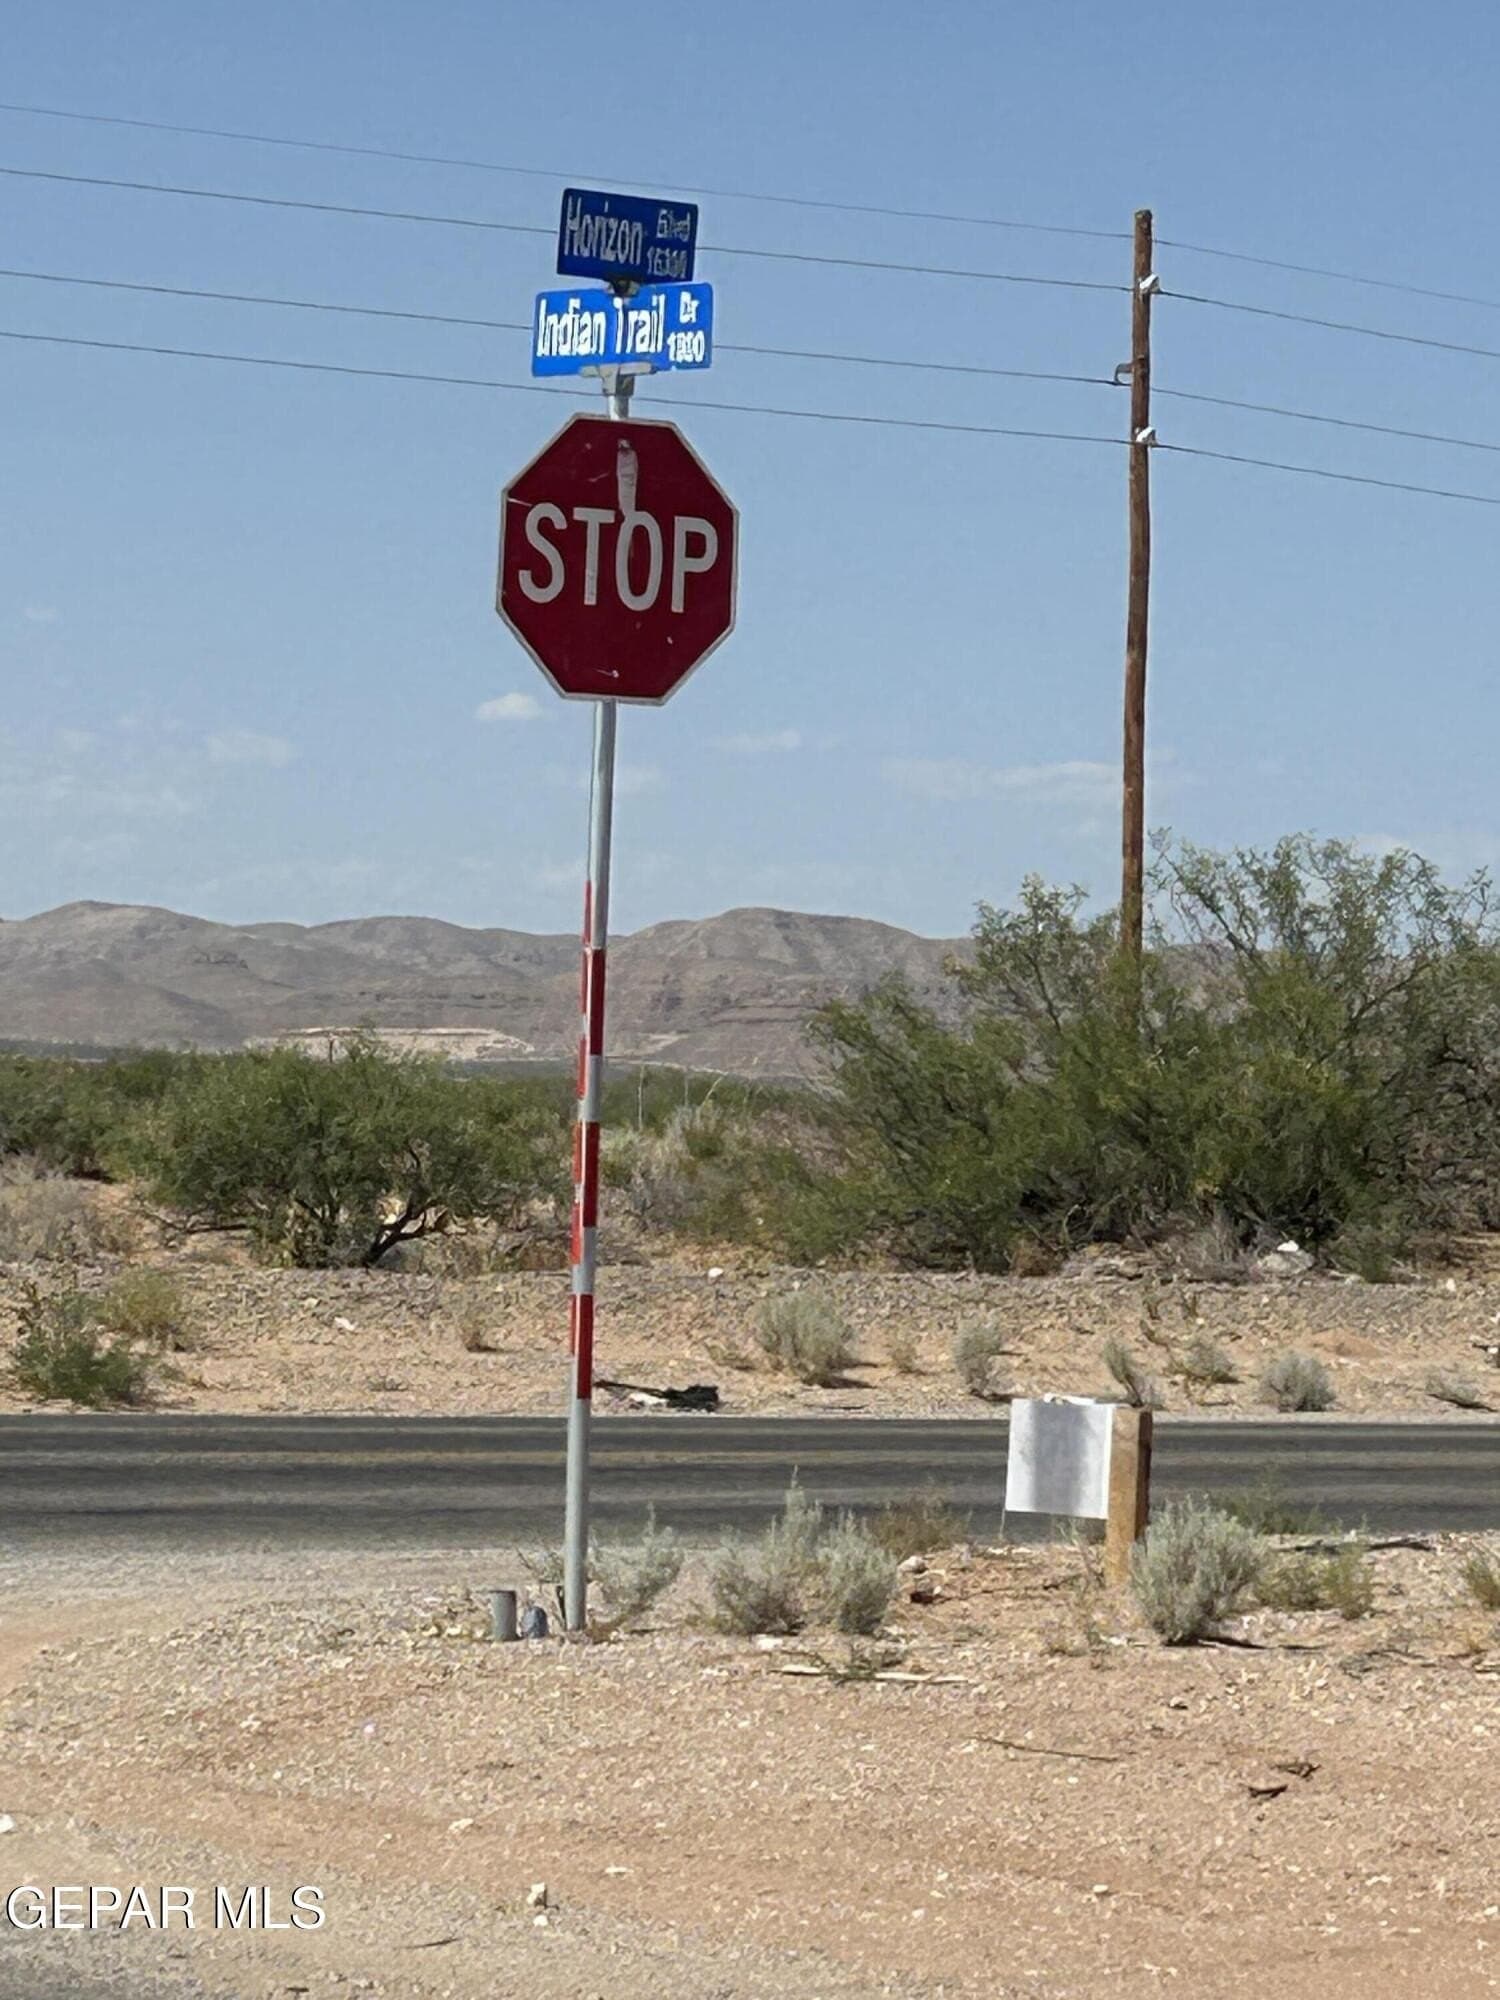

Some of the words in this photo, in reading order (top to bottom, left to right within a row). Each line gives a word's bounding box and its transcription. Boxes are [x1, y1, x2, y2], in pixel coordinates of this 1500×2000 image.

[564, 196, 643, 265] Horizon
[537, 298, 606, 357] Indian
[613, 295, 665, 355] Trail
[679, 291, 700, 324] Dr
[518, 503, 718, 613] STOP
